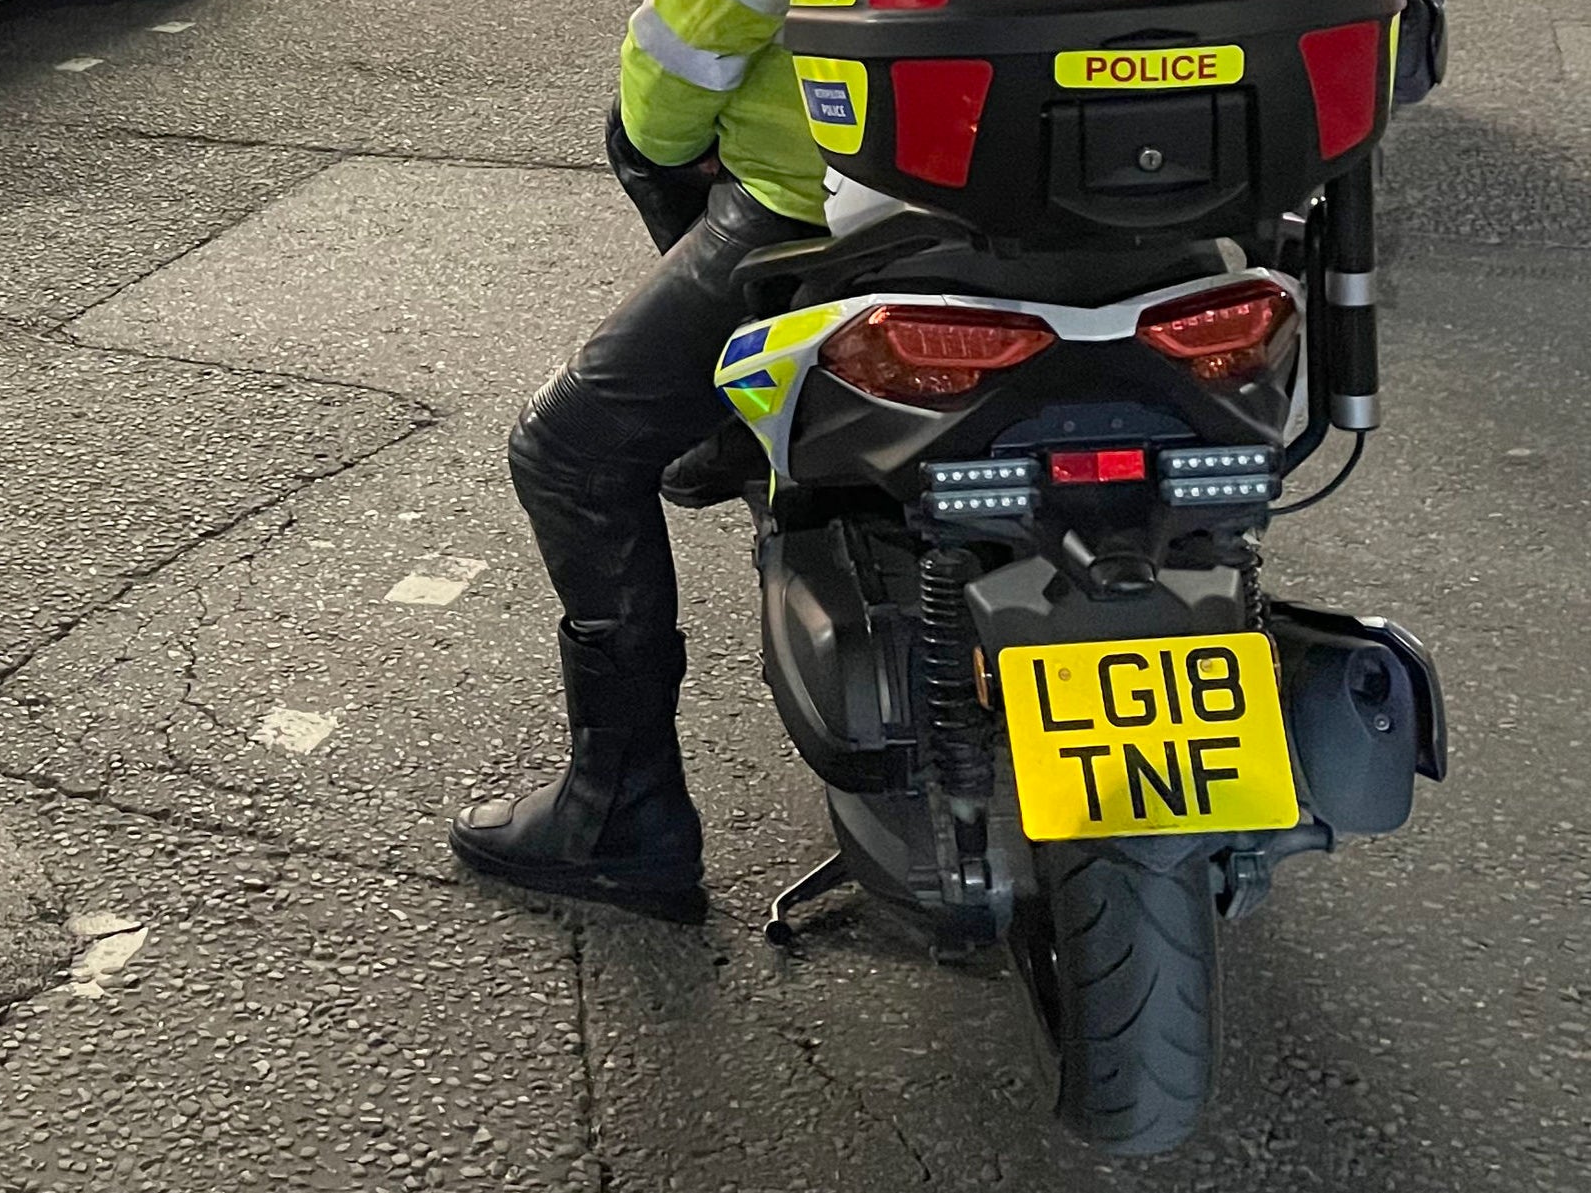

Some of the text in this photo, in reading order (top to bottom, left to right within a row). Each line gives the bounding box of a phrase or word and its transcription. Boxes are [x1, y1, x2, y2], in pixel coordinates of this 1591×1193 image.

[1086, 54, 1218, 83] POLICE
[821, 103, 847, 118] POLICE
[1033, 646, 1246, 732] LG18
[1059, 737, 1241, 822] TNF
